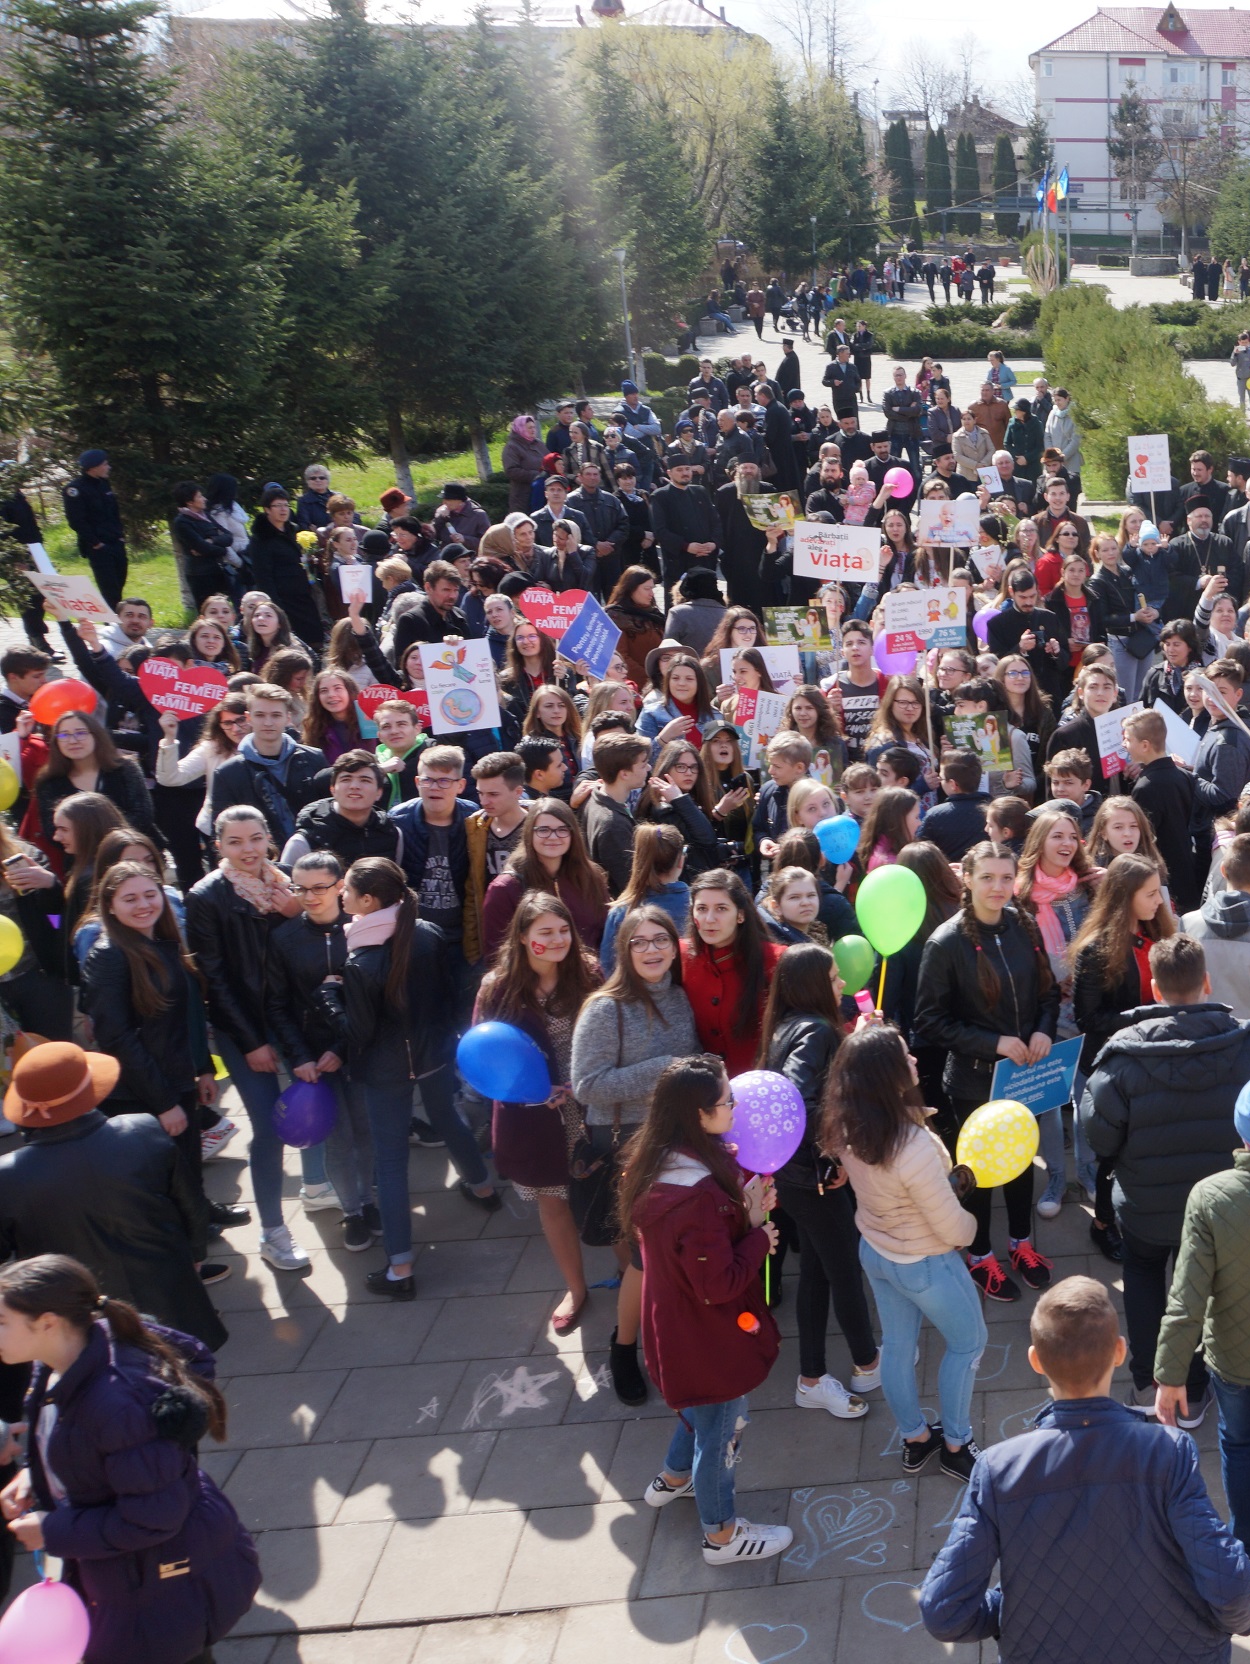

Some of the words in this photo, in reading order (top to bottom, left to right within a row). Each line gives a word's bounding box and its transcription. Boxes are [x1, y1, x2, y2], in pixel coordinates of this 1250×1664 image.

[810, 549, 863, 572] viața
[535, 619, 572, 630] FAMIL
[144, 662, 179, 680] VIAȚĂ
[173, 681, 226, 701] FEMEIE
[151, 694, 205, 715] FAMILIE
[1011, 1065, 1037, 1079] Avortul
[1047, 1058, 1063, 1067] este
[1046, 1076, 1062, 1085] este
